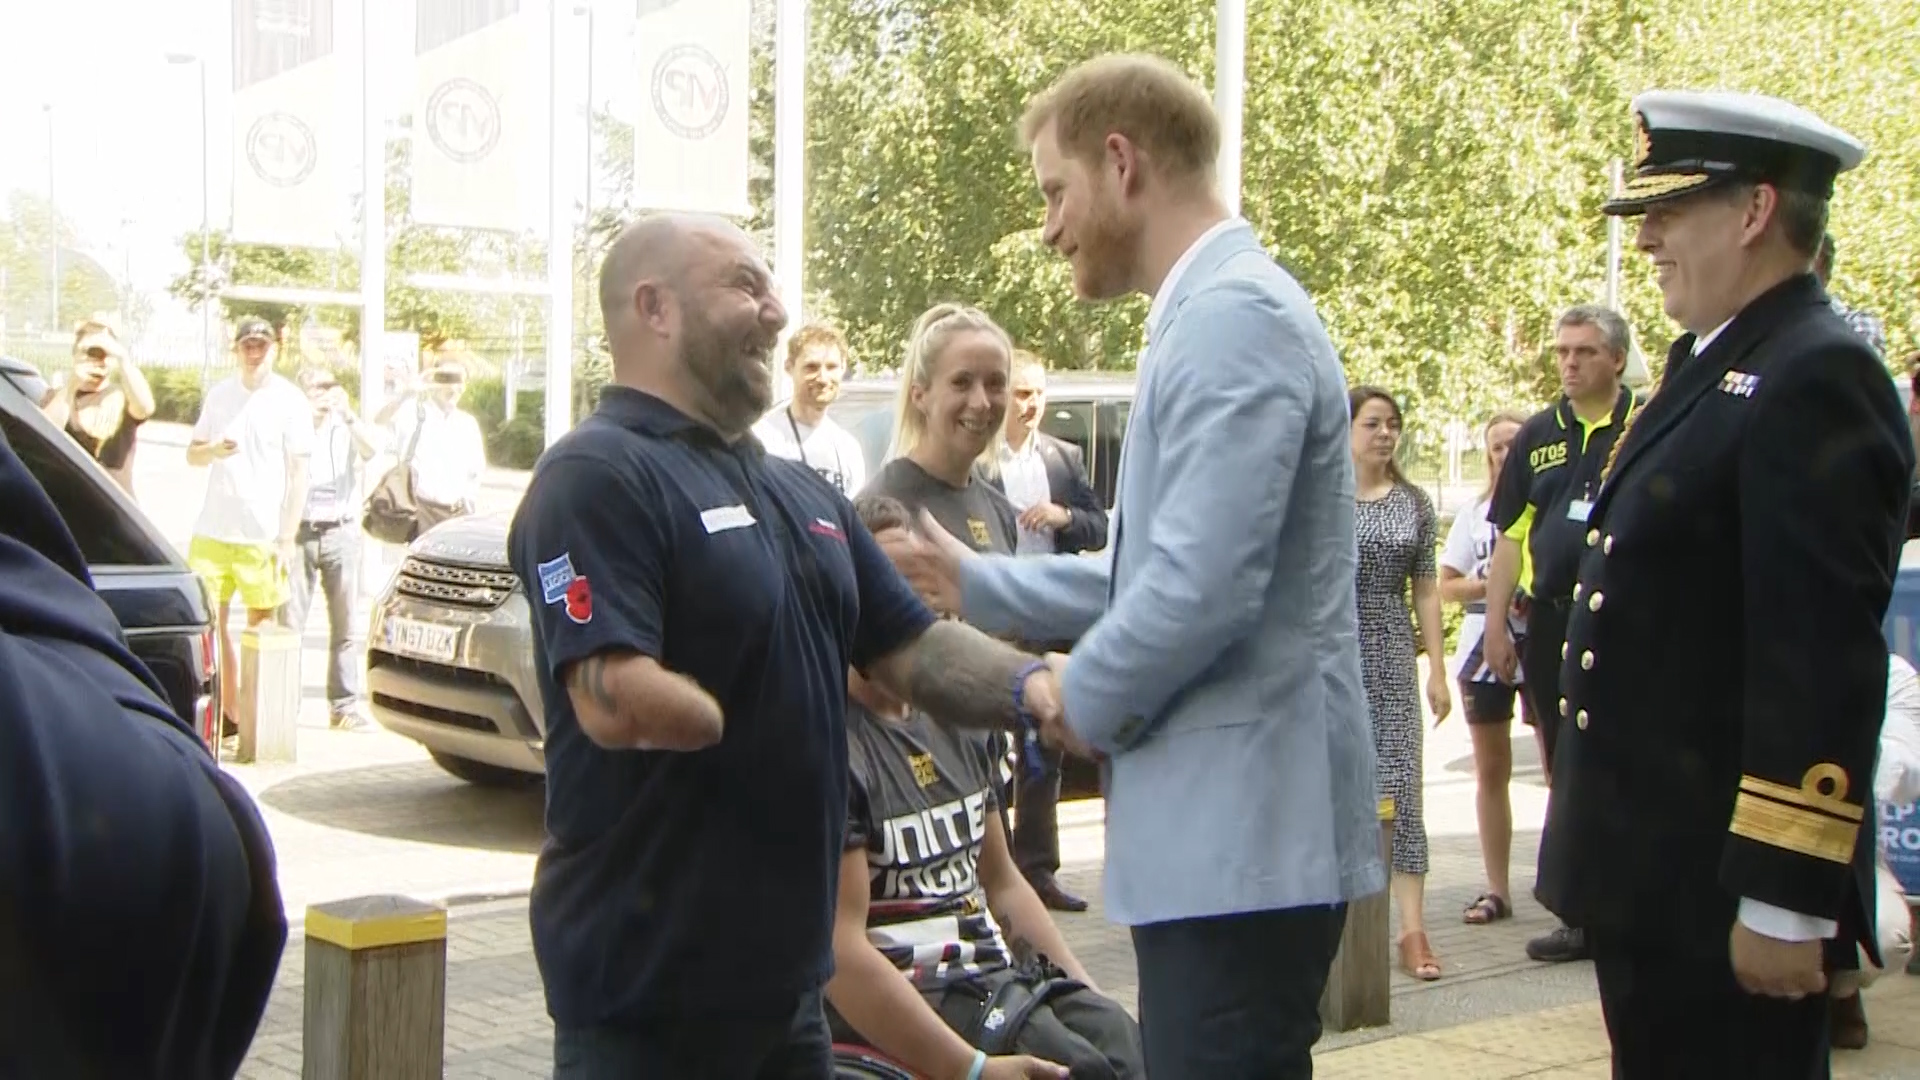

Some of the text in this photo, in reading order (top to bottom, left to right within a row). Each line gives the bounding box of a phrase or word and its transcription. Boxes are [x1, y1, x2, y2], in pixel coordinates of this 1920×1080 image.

[1529, 441, 1567, 467] 0705
[868, 790, 987, 866] UNITE
[1880, 826, 1920, 850] RO
